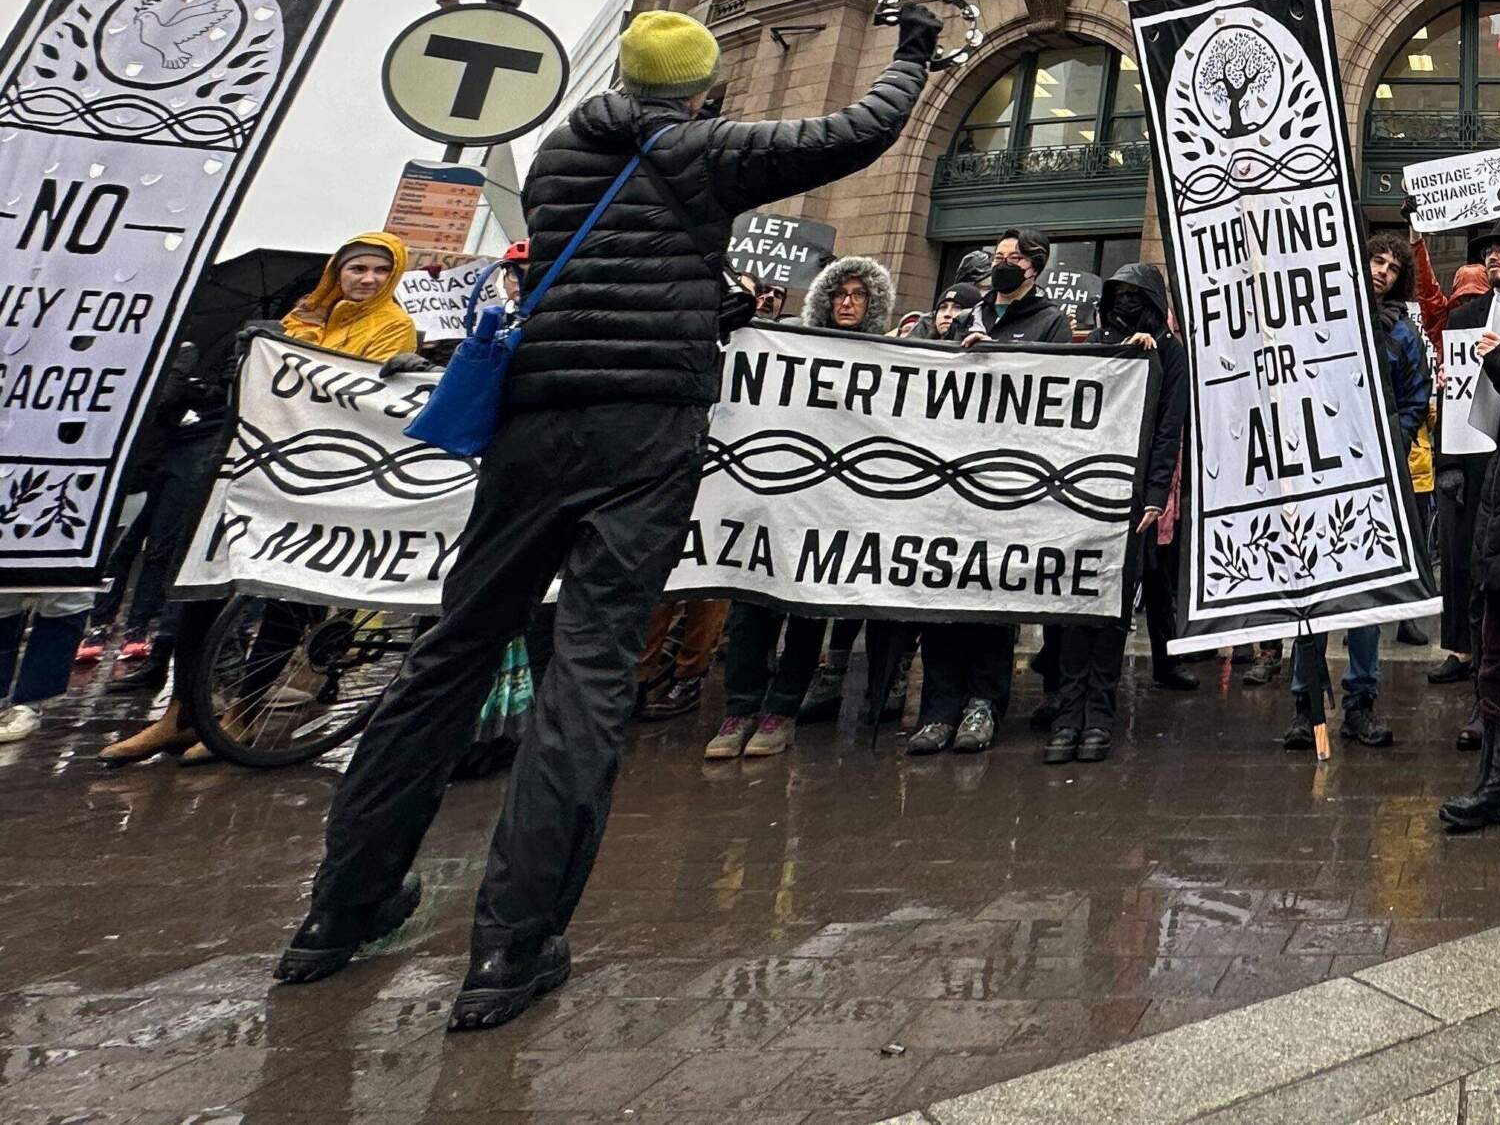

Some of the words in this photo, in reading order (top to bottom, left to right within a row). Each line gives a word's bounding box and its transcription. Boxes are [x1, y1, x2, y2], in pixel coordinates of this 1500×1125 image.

[424, 34, 544, 120] T
[1411, 167, 1472, 191] HOSTAGE
[1414, 181, 1486, 207] EXCHANGE
[16, 178, 129, 254] NO
[748, 217, 799, 239] LET
[1416, 205, 1447, 222] NOW
[731, 258, 792, 282] IVE
[1045, 286, 1088, 302] AFAH
[1048, 272, 1081, 286] LET
[0, 285, 66, 328] EY
[67, 290, 153, 334] FOR
[1200, 261, 1348, 347] FUTURE
[272, 353, 386, 412] OUR
[1253, 343, 1298, 390] FOR
[1245, 397, 1343, 486] ALL
[250, 522, 463, 582] MONEY
[671, 518, 775, 577] AZA
[794, 528, 1104, 597] MASSACRE
